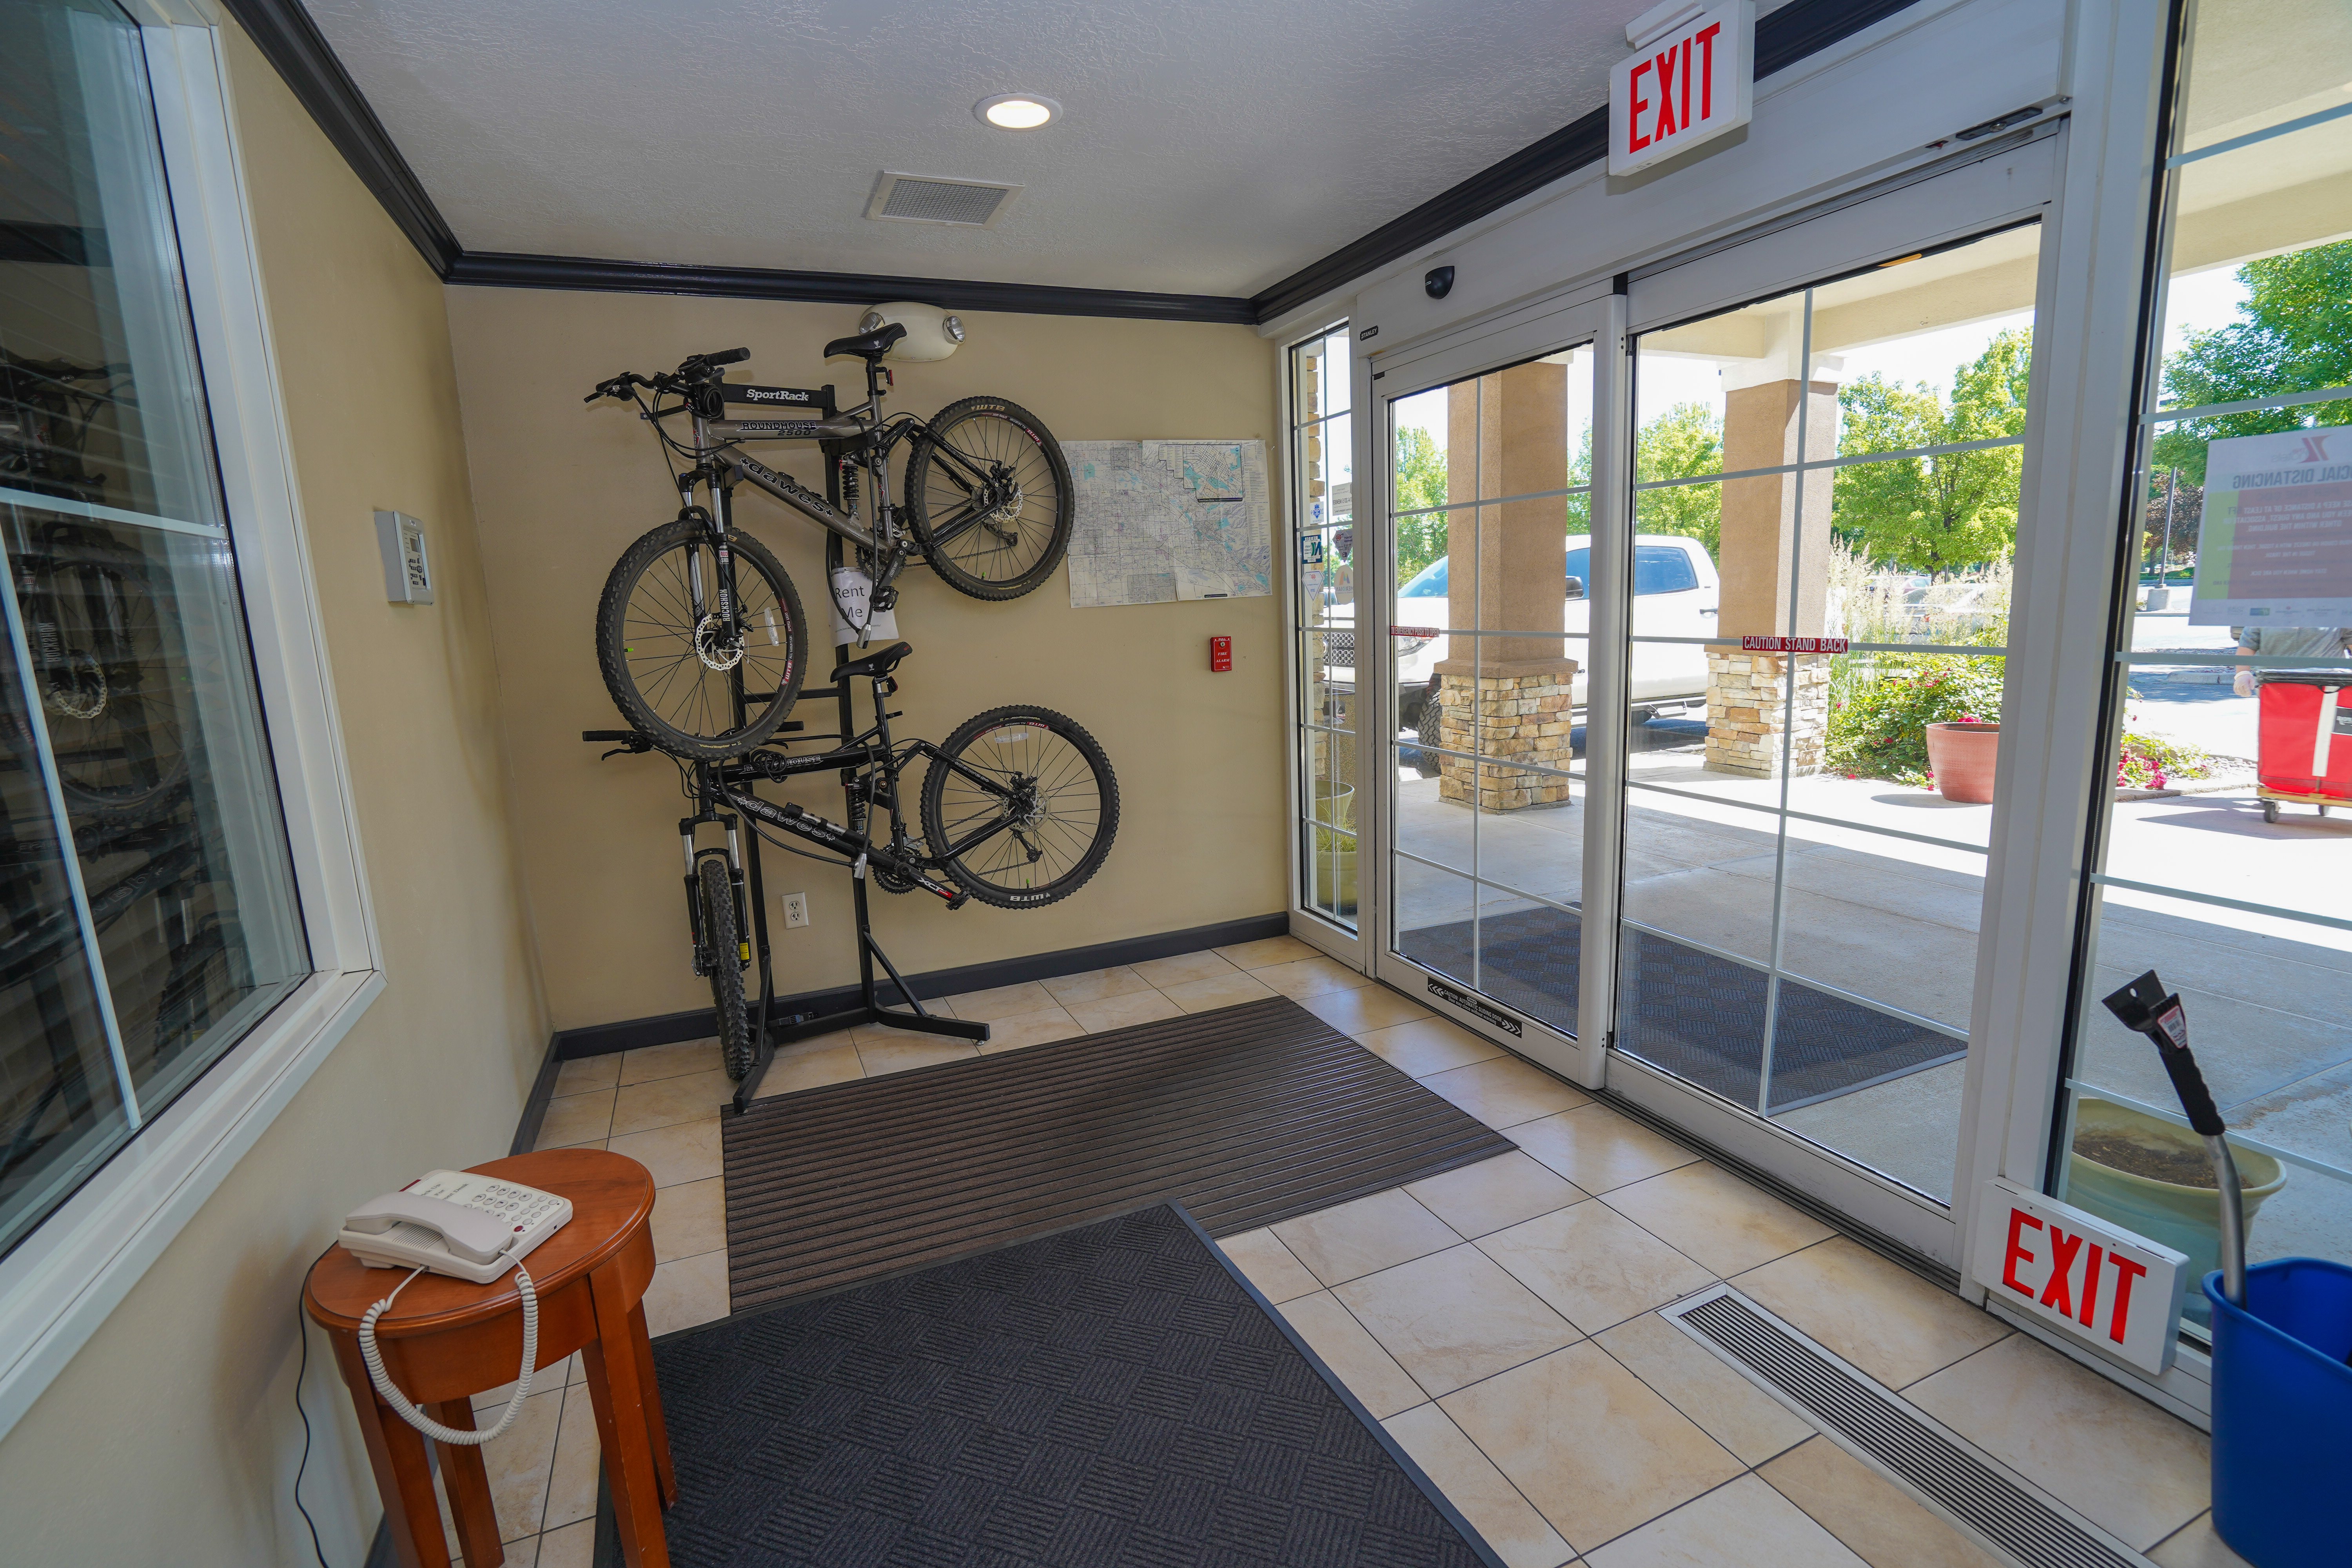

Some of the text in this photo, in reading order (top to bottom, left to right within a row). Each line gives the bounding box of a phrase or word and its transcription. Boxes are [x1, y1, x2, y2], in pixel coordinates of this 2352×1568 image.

[1630, 21, 1720, 154] EXIT
[1361, 328, 1377, 339] STANLEY
[746, 389, 809, 401] SportRack
[740, 421, 818, 430] ROUNDHOUSE
[1027, 429, 1039, 441] WTB
[748, 463, 825, 513] dawes
[835, 586, 865, 599] Rent
[719, 589, 731, 622] ROCKSHOX
[841, 606, 863, 619] Me
[1744, 636, 1847, 652] CAUTION STAND BACK
[746, 800, 827, 838] dawes
[917, 877, 944, 891] XCT
[1459, 997, 1478, 1011] AUTOMATIC
[1478, 1006, 1492, 1017] SLIDING
[1492, 1013, 1502, 1022] DOOR
[2002, 1207, 2147, 1345] EXIT
